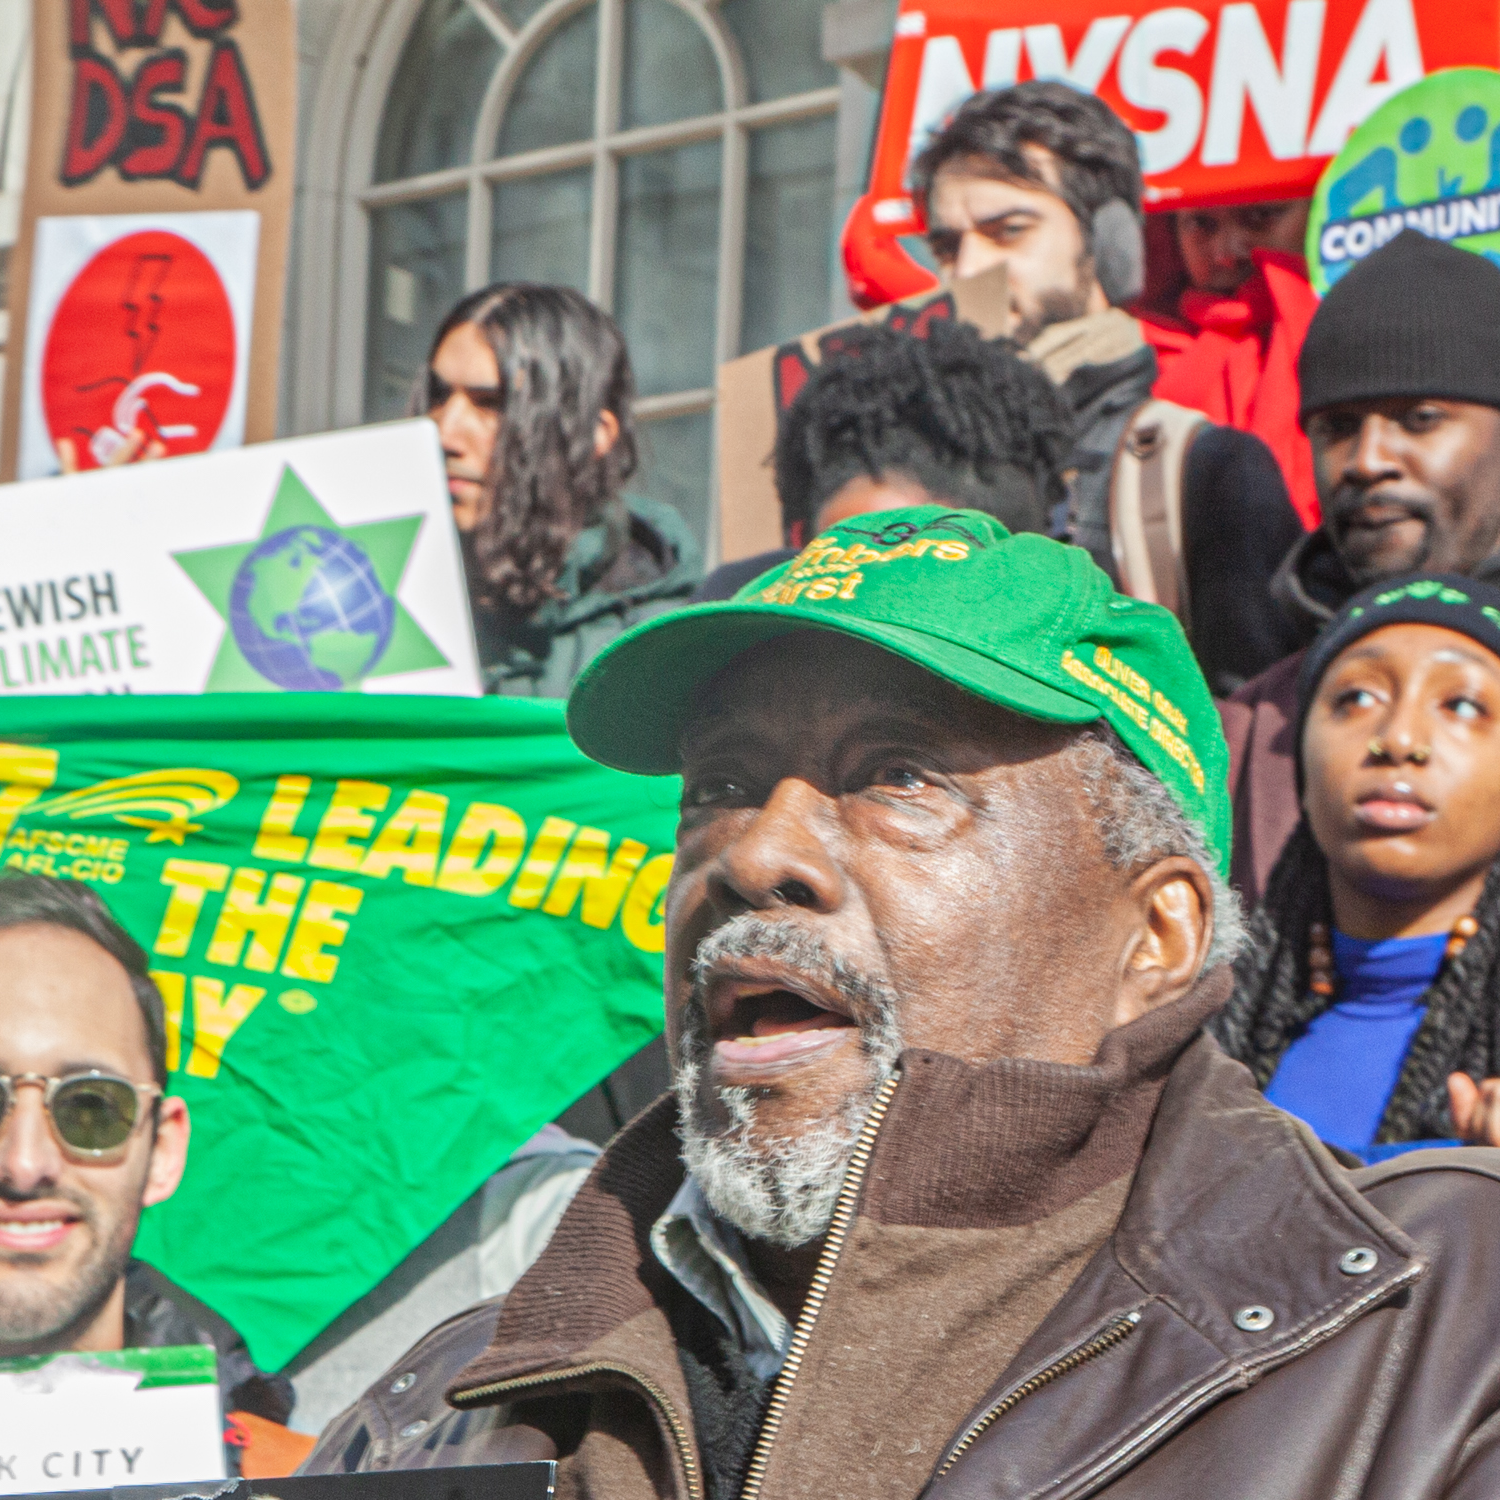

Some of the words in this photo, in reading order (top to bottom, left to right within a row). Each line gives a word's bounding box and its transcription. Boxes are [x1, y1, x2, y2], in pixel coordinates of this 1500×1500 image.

[59, 37, 272, 191] DSA
[4, 826, 130, 862] AFSCME
[252, 764, 677, 953] LEADING
[153, 857, 364, 984] THE
[41, 1445, 145, 1479] CITY
